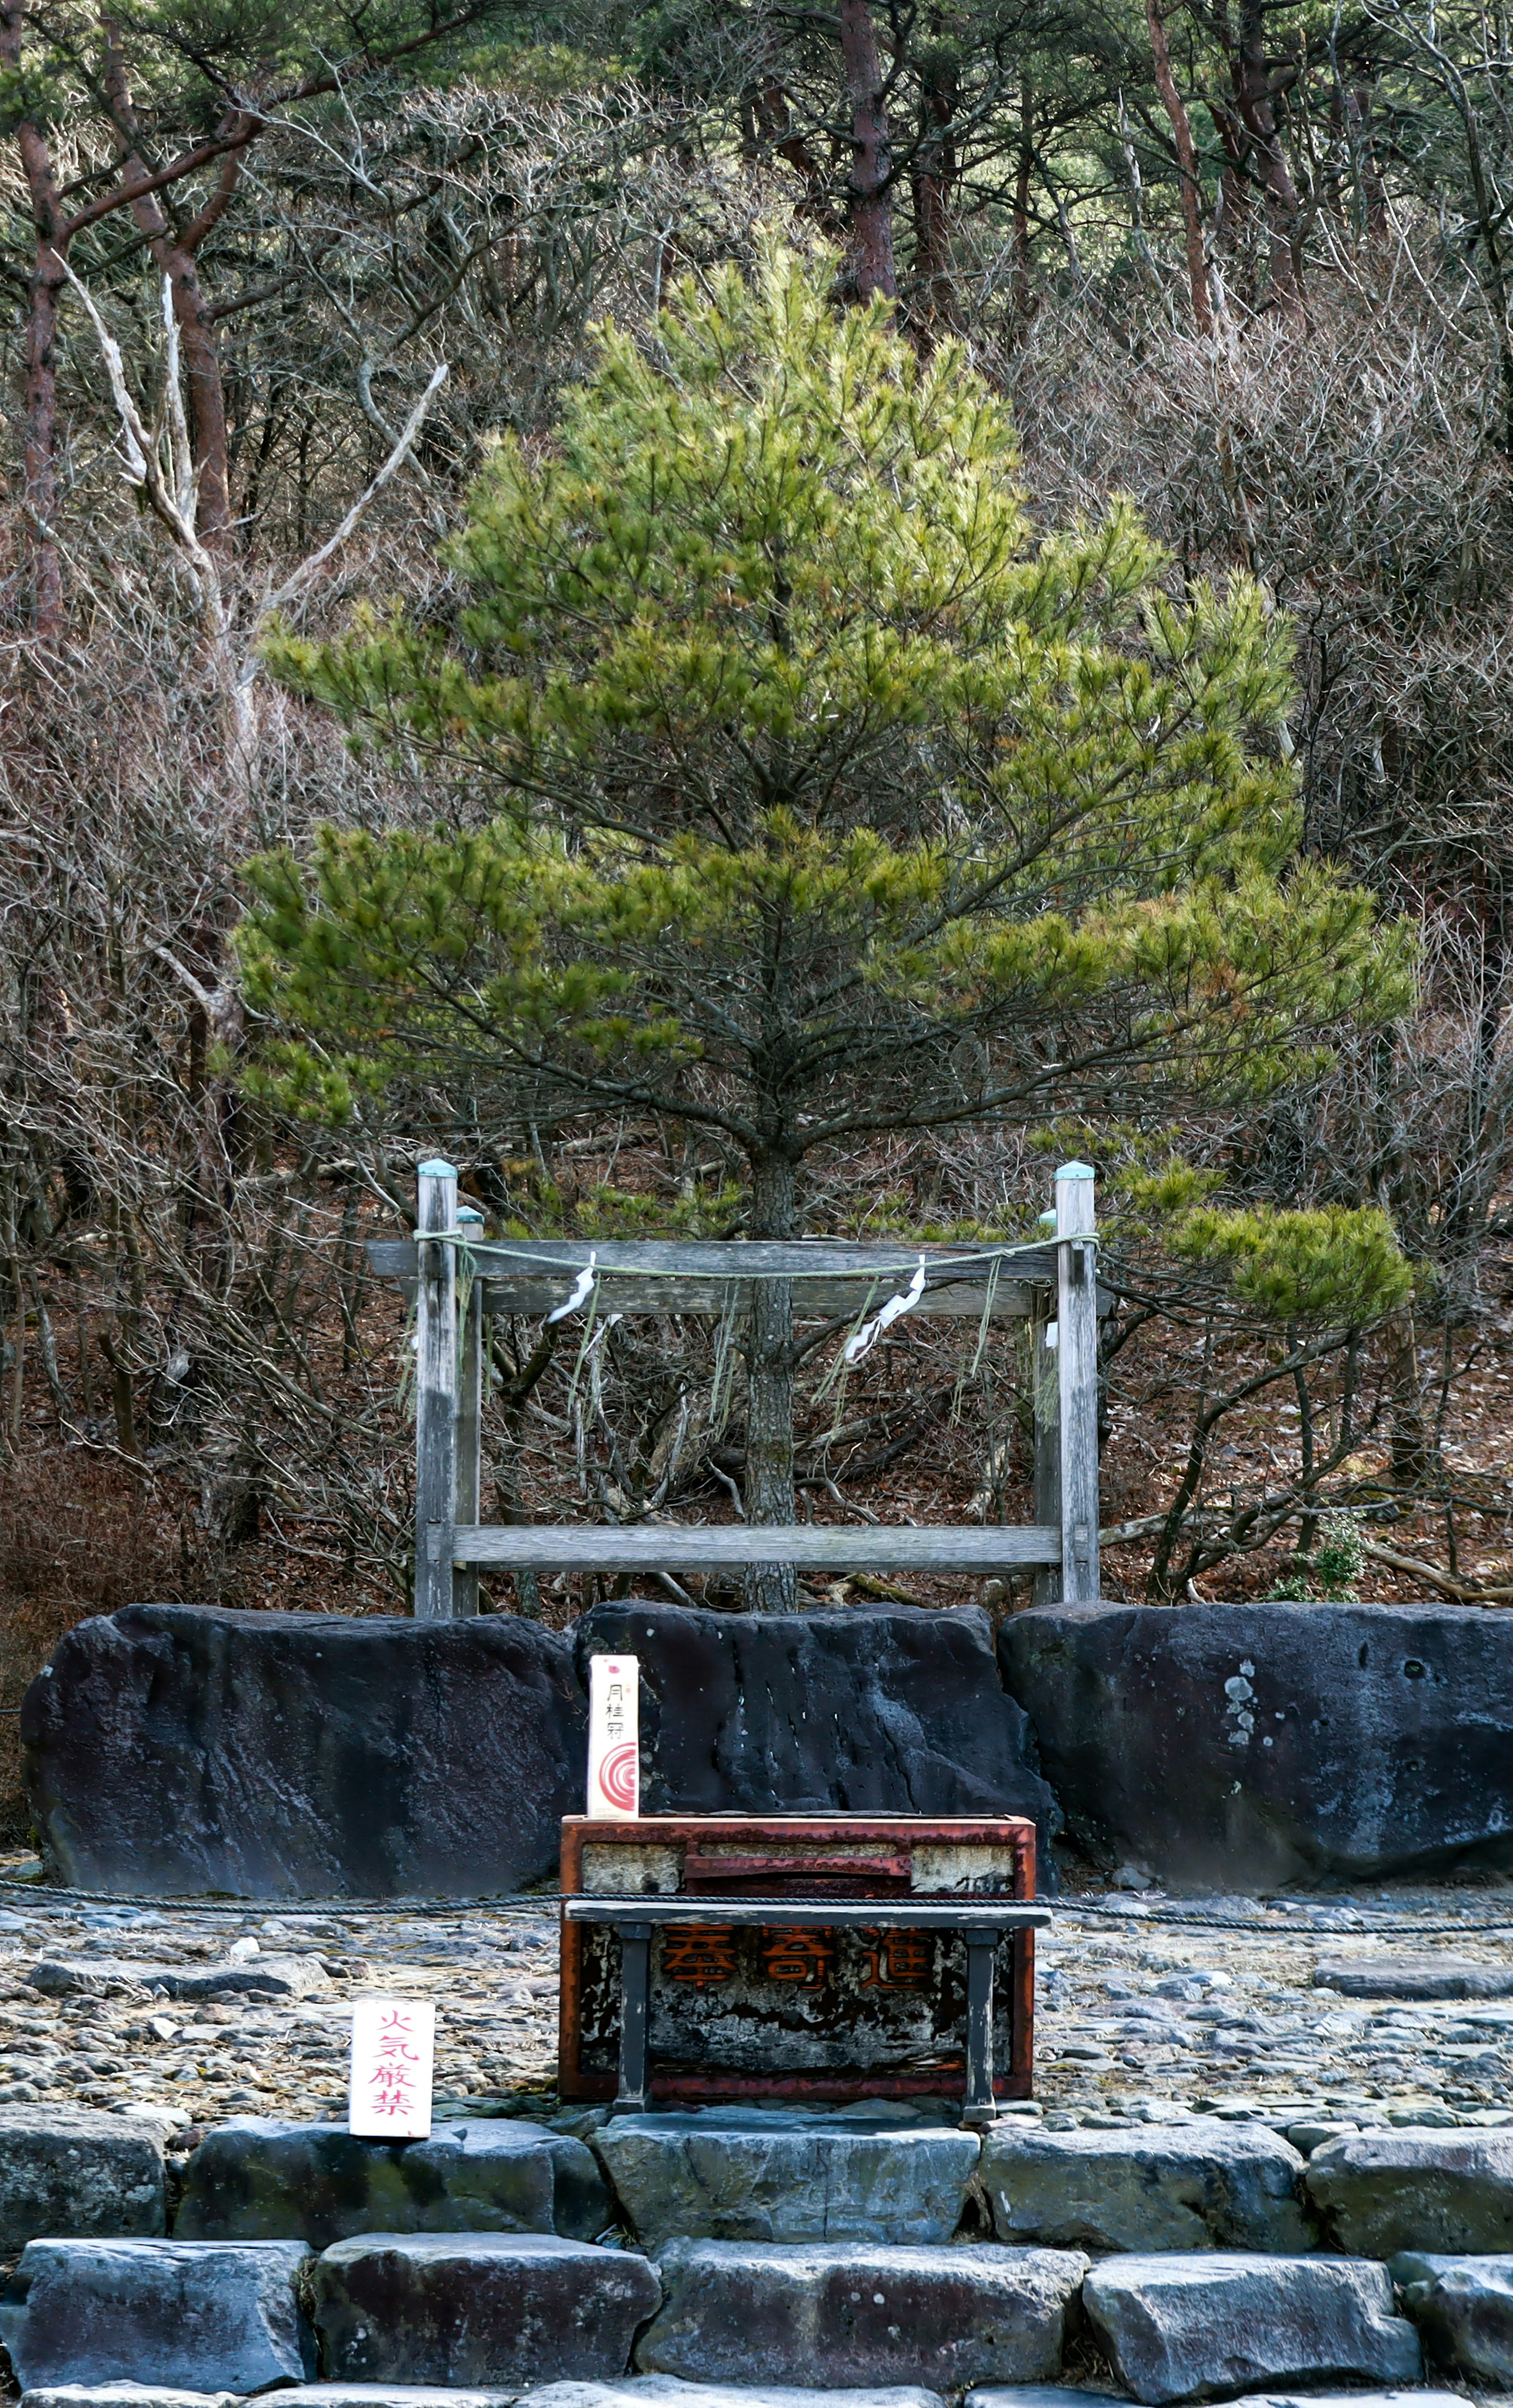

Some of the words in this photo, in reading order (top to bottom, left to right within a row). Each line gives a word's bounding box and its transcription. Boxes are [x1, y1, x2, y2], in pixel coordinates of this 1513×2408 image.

[606, 1684, 624, 1739] 月桂冠
[368, 2010, 420, 2116] 火気厳禁
